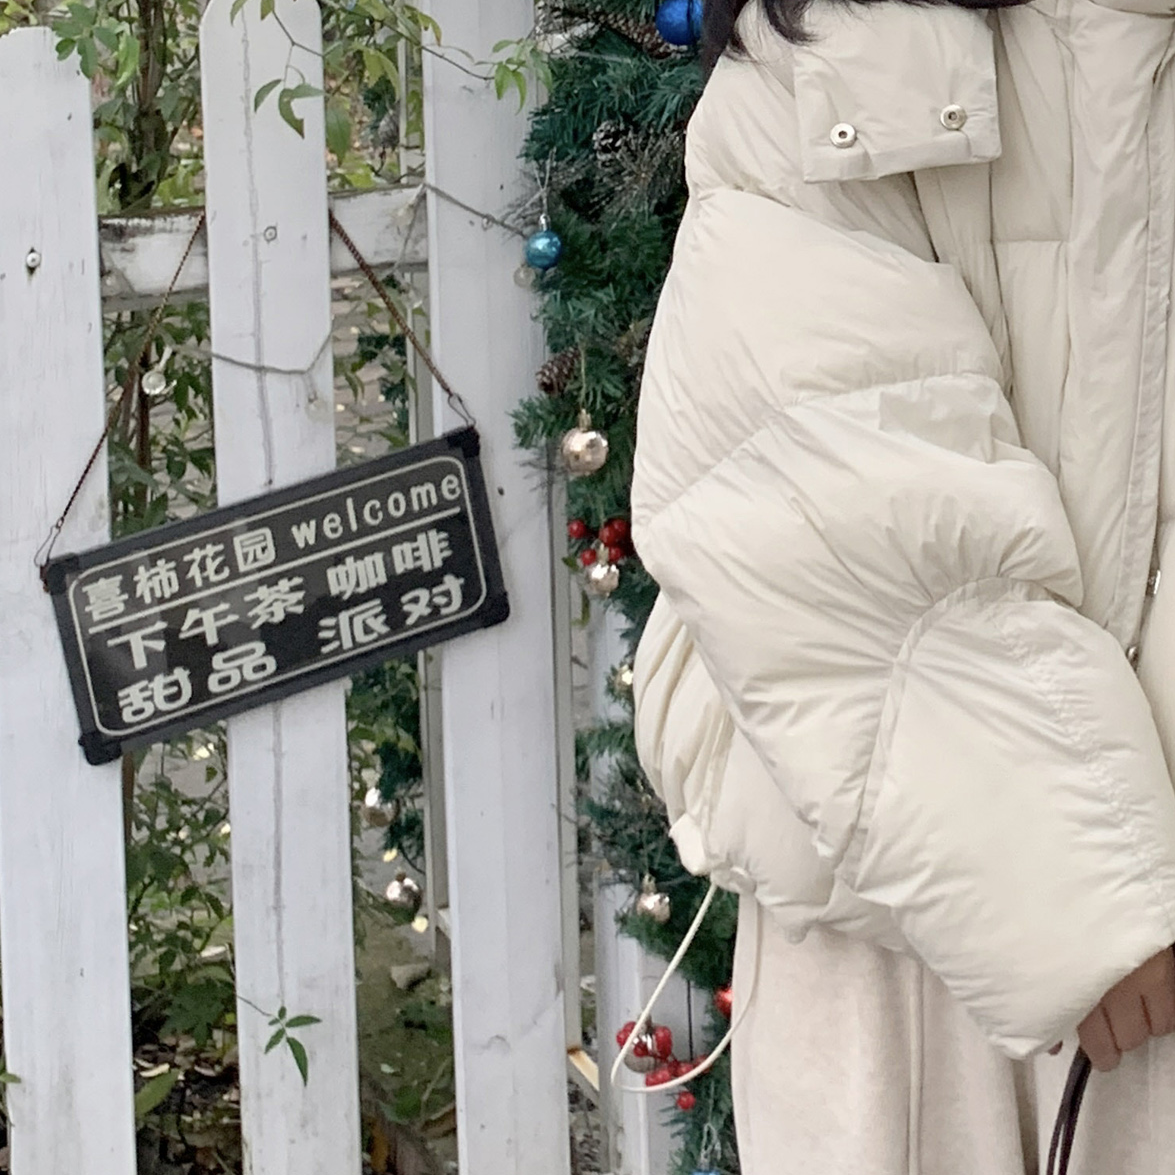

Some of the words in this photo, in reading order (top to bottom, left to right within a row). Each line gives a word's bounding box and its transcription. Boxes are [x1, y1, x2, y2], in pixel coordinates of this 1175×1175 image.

[82, 527, 277, 622] 喜柿花园
[292, 473, 462, 550] welcome
[107, 577, 305, 670] 下午茶
[327, 529, 452, 599] 咖啡
[118, 641, 277, 723] 甜品
[318, 574, 464, 654] 派对
